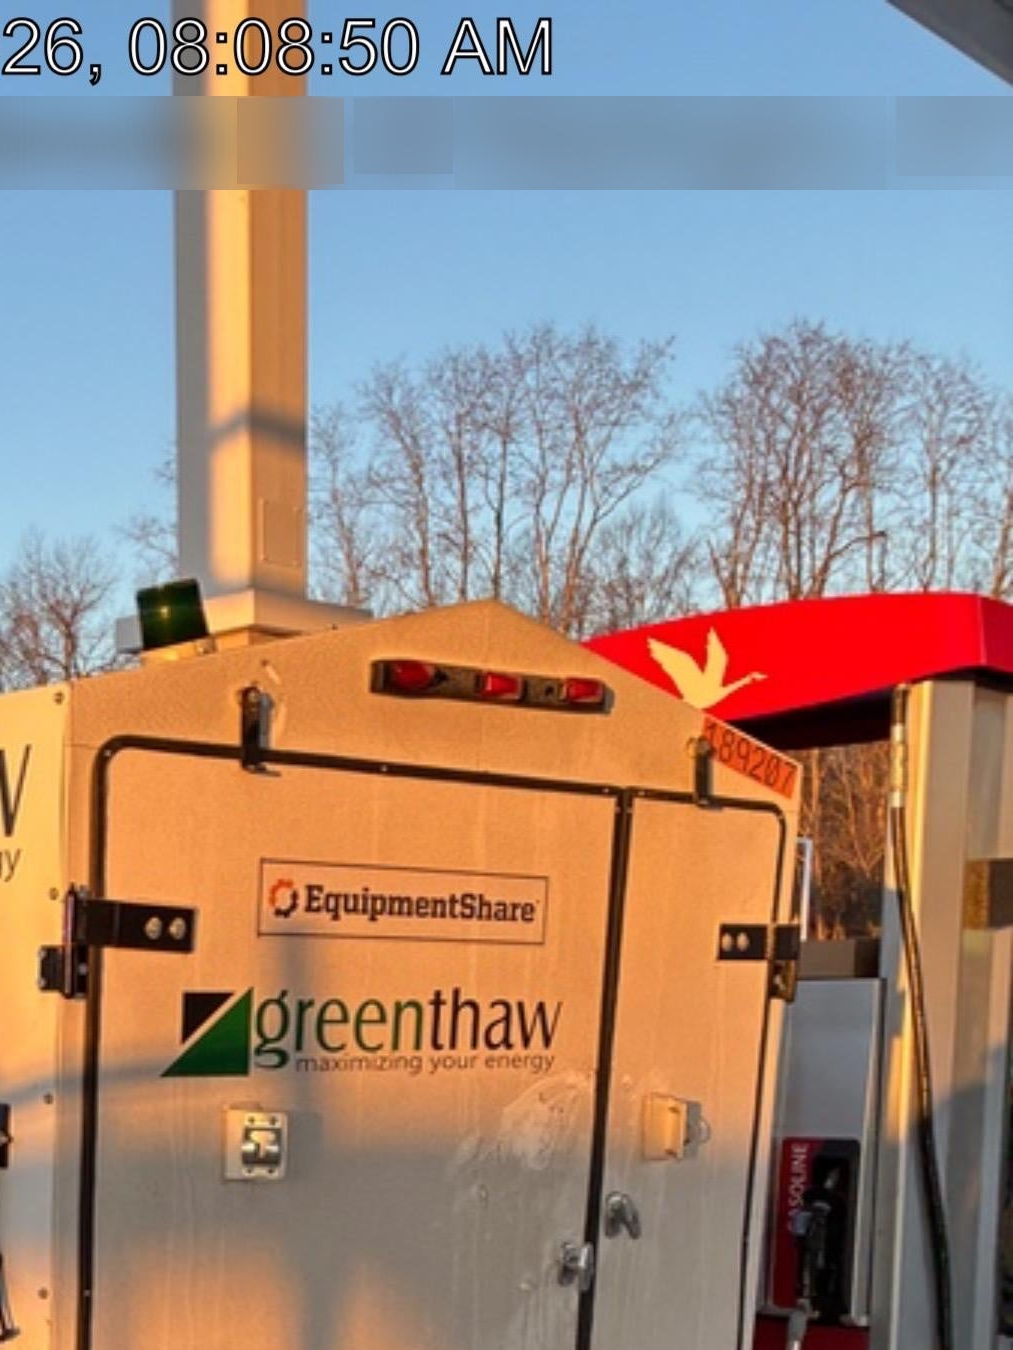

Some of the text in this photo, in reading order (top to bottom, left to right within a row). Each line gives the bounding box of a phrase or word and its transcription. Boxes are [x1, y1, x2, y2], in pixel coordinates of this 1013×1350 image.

[304, 884, 535, 922] EquipmentShare
[254, 987, 562, 1069] greenthaw
[296, 1052, 556, 1075] maximizing your energy
